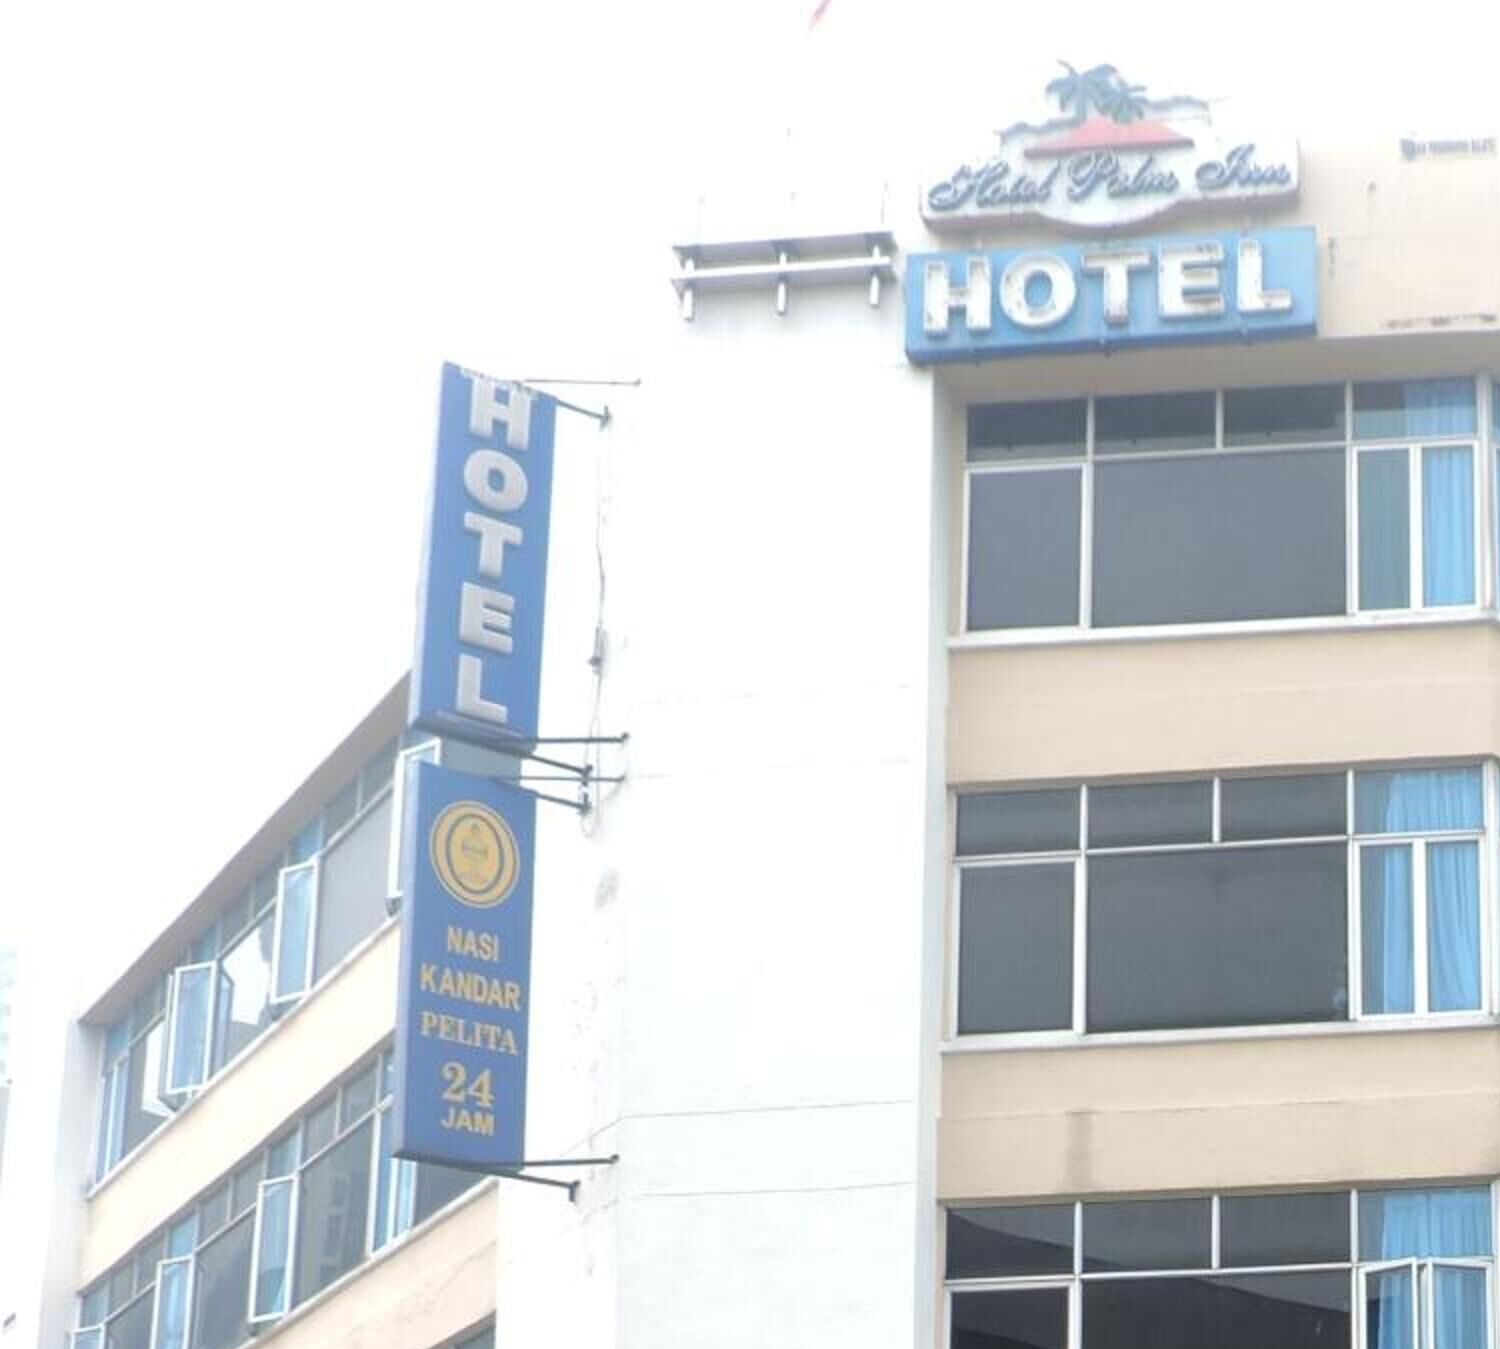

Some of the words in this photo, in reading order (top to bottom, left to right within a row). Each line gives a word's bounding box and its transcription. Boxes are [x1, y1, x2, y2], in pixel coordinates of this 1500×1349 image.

[927, 158, 1061, 212] Hotel
[1066, 151, 1180, 202] Palm
[922, 239, 1294, 338] HOTEL
[456, 367, 532, 725] HOTEL
[447, 925, 499, 962] NASI
[419, 961, 522, 1012] KANDAR
[421, 1010, 520, 1056] PELITA
[441, 1060, 496, 1108] 24
[440, 1107, 496, 1137] JAM
